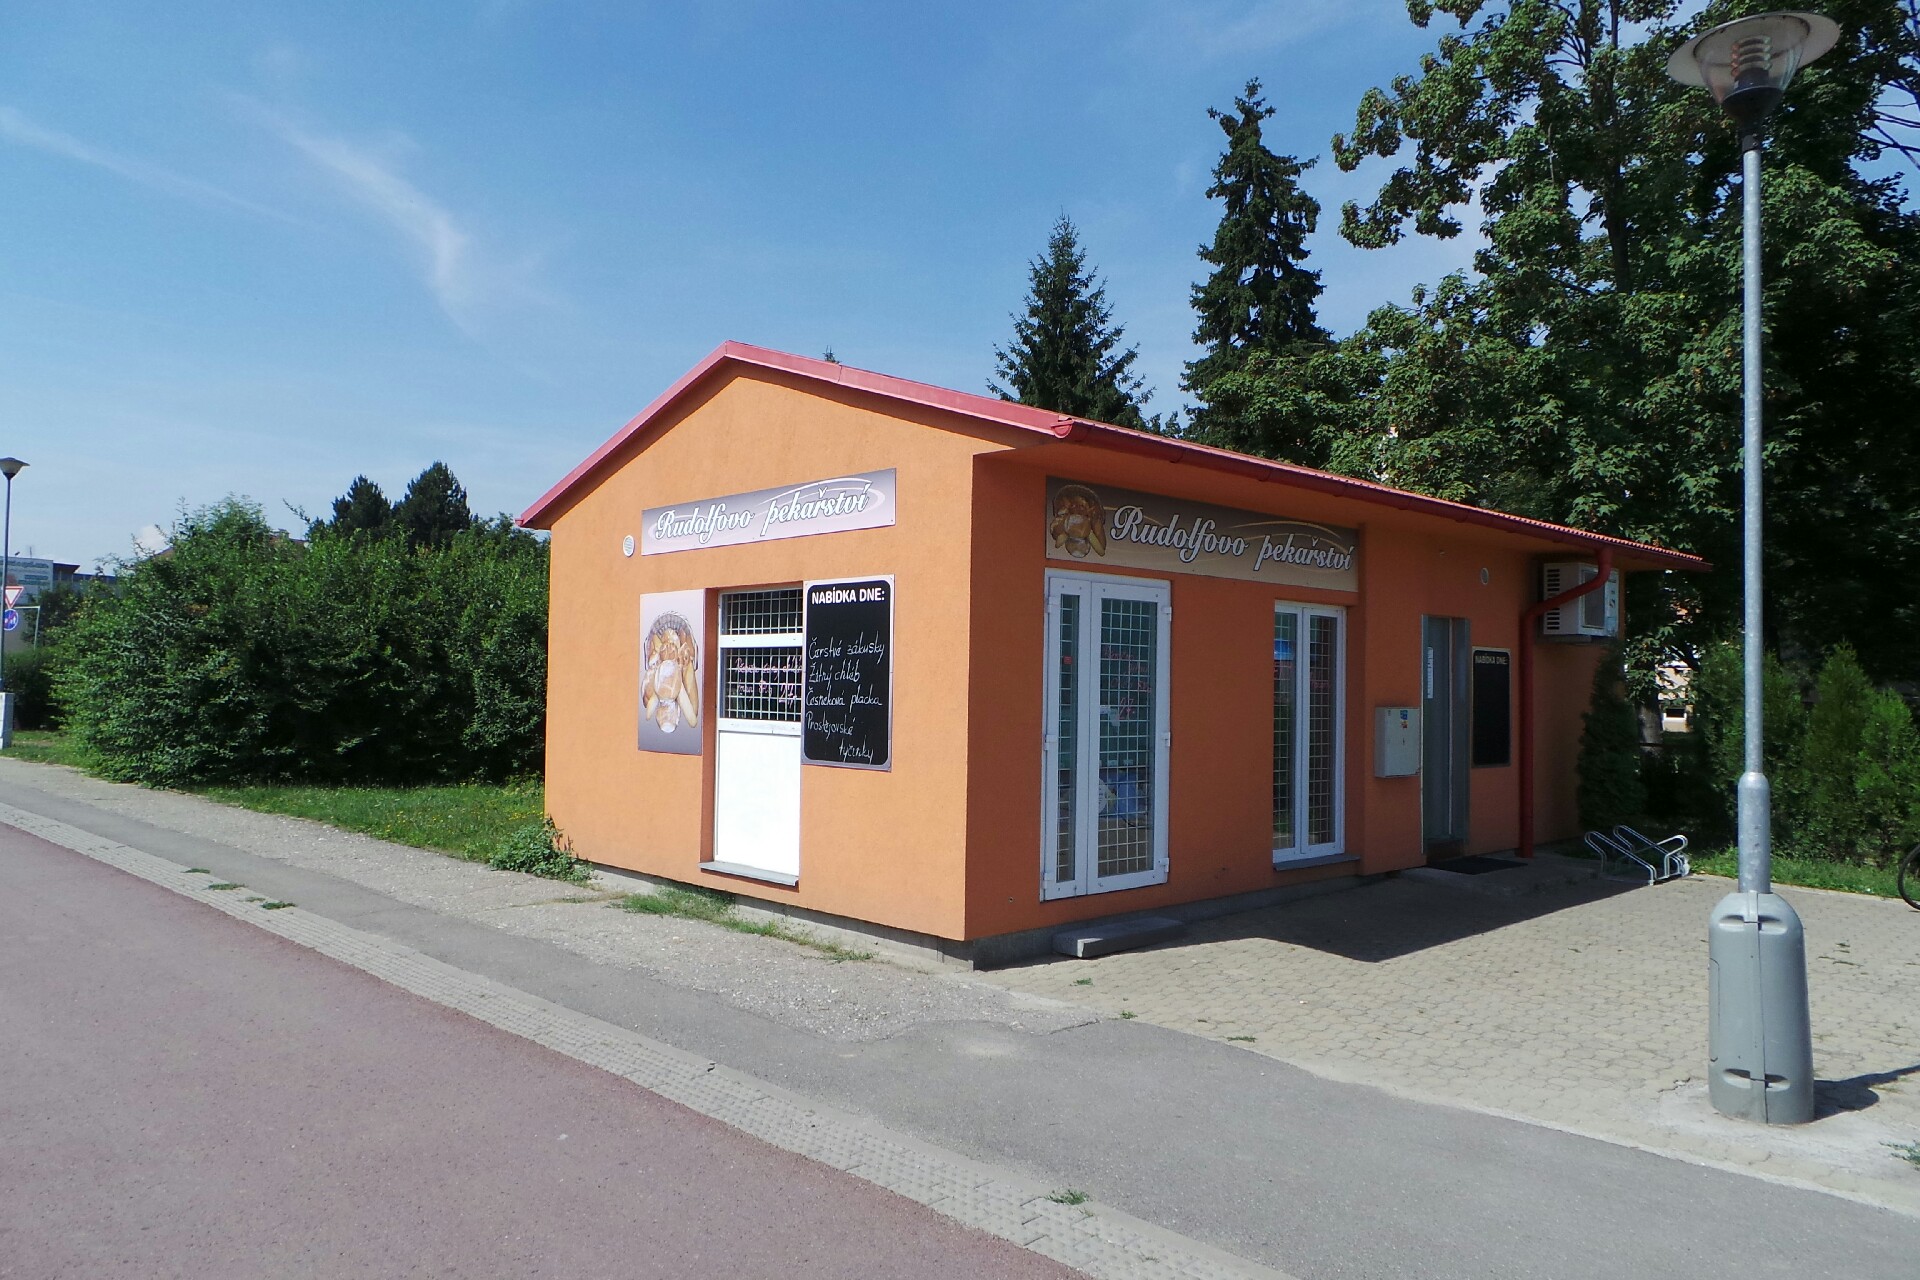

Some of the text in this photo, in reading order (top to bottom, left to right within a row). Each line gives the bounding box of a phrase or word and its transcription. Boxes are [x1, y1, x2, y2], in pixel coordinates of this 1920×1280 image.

[655, 483, 872, 544] Rudolfovo pekařství
[1110, 505, 1354, 571] Rudolfovo pekařství
[811, 587, 885, 605] NABÍDKA DNE:
[846, 630, 885, 665] zákusky
[834, 658, 861, 682] chléb
[849, 684, 883, 713] placka
